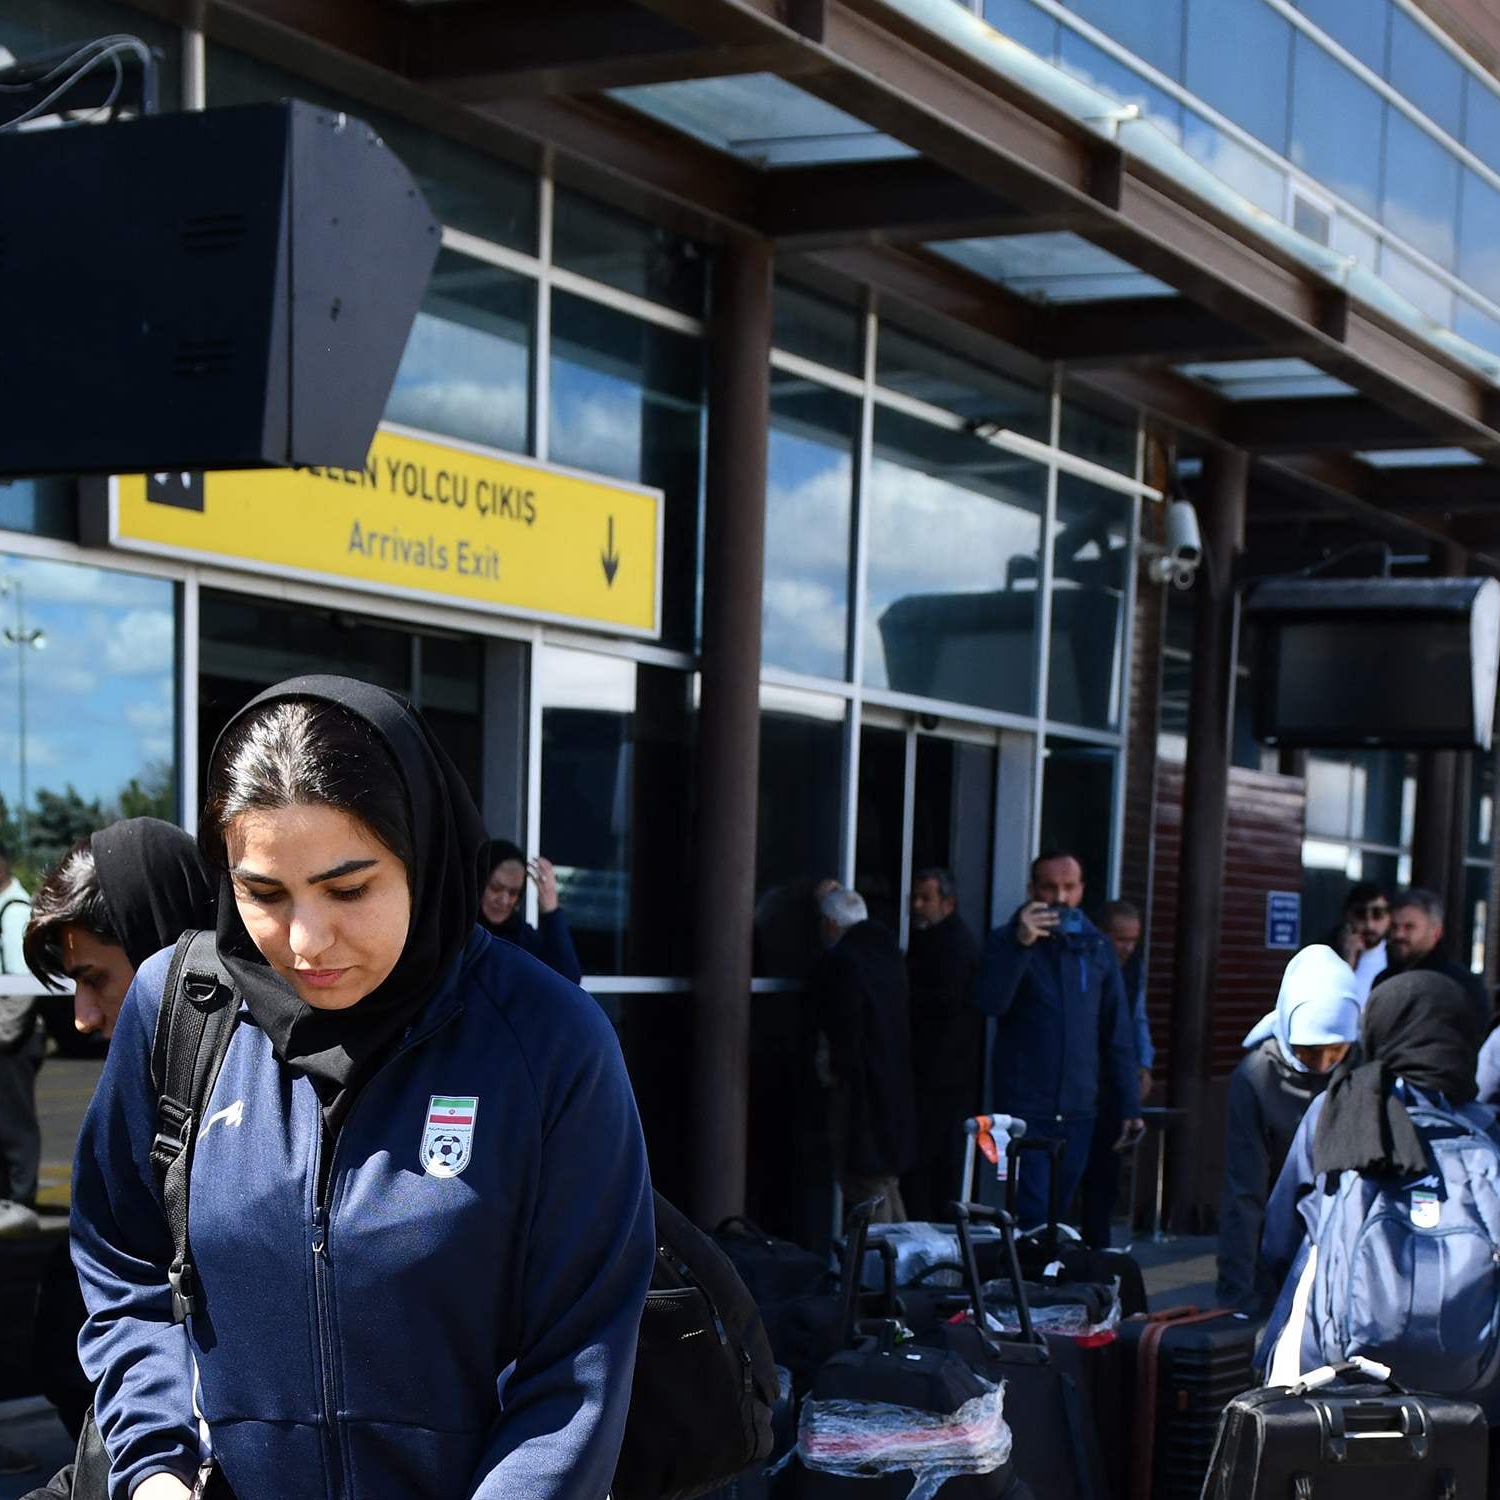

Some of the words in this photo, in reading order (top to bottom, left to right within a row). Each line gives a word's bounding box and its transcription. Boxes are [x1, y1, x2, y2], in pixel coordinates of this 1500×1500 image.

[386, 457, 469, 509] YOLCU
[349, 518, 450, 572] Arrivals
[455, 541, 501, 581] Exit
